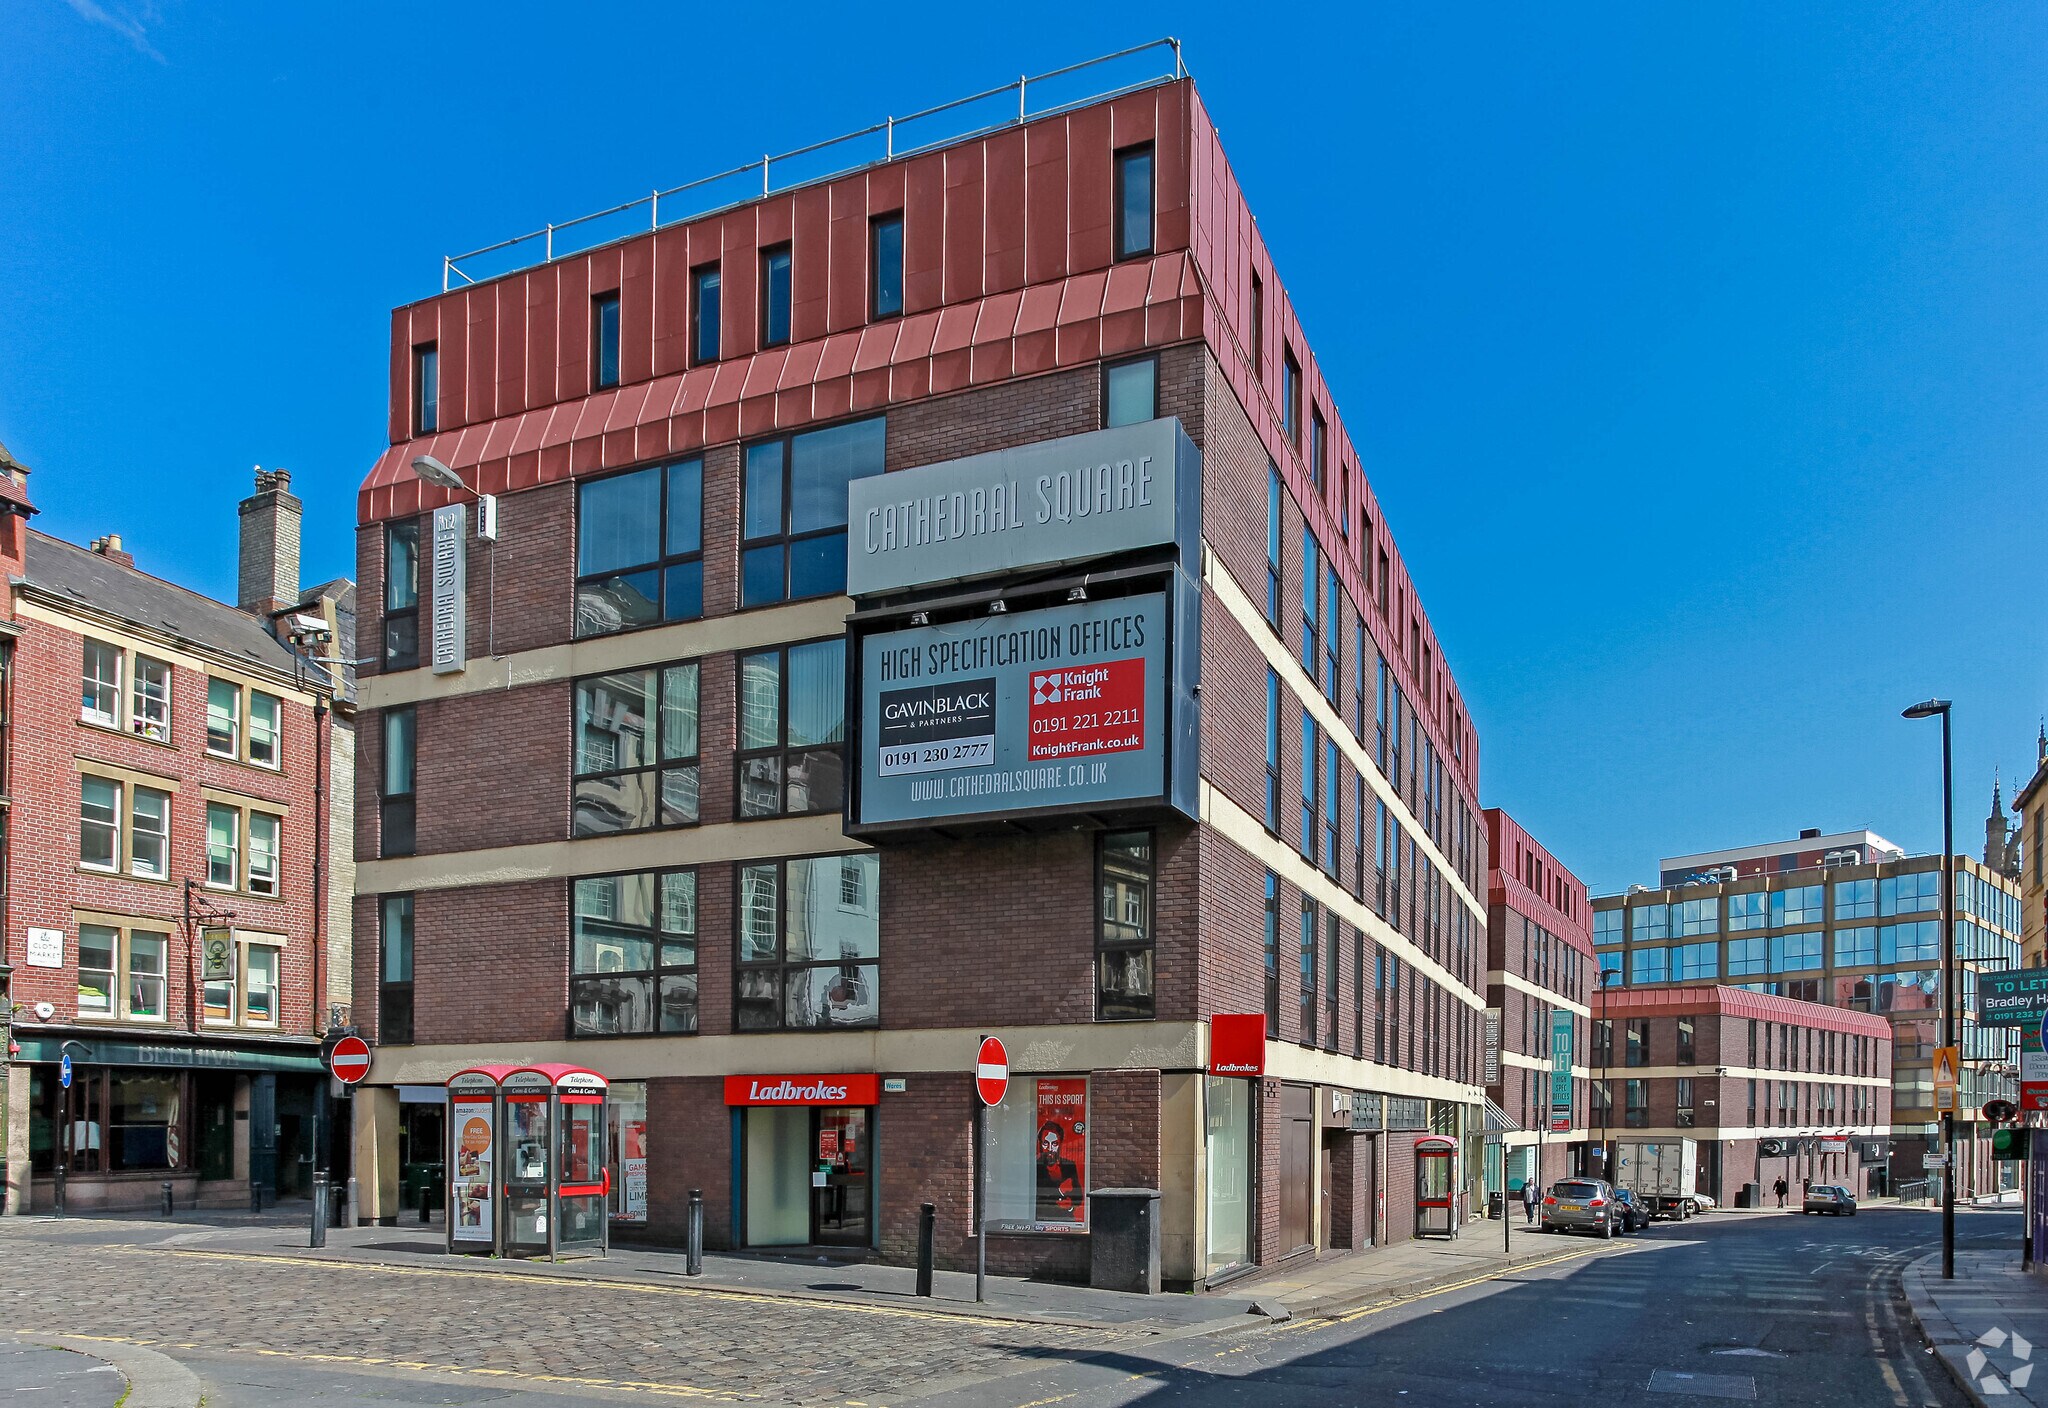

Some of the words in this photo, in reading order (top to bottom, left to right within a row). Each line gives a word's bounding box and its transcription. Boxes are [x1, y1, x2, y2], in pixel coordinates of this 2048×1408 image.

[865, 481, 1023, 554] CATHEDRAL
[1036, 456, 1152, 524] SQUARE
[437, 532, 456, 588] SQUARE
[436, 588, 455, 665] CATHEDRAL
[881, 646, 921, 681] HIGH
[928, 626, 1060, 675] SPECIFICATION
[1070, 614, 1145, 656] OFFICES
[1064, 668, 1109, 687] Knight
[1064, 685, 1102, 702] Frank
[885, 692, 989, 719] GAVINBLACK
[919, 716, 962, 727] PARTNERS
[1033, 716, 1068, 734] 0191
[1072, 713, 1099, 730] 221
[1103, 708, 1140, 726] 2211
[1033, 734, 1139, 757] KnightFrank.co.uk
[885, 751, 917, 767] 0191
[923, 747, 949, 763] 230
[953, 743, 989, 759] 2777
[911, 762, 1107, 801] WWW.CATHEDRALSQUARE.CO.UK
[33, 942, 59, 950] CLOTH
[30, 951, 60, 959] MARKET
[1982, 973, 2022, 981] RESTAURANT
[1995, 981, 2015, 993] TO
[2020, 978, 2048, 991] LET
[1986, 996, 2033, 1009] Bradley
[1994, 1012, 2014, 1020] 0191
[1486, 1021, 1497, 1046] SQUARE
[1555, 1033, 1568, 1052] TO
[1216, 1063, 1258, 1072] Ladbrokes
[1486, 1047, 1497, 1082] CATHEDRAL
[1553, 1053, 1571, 1071] LET
[461, 1076, 484, 1085] Telephone
[515, 1076, 539, 1084] Telephone
[570, 1076, 594, 1085] Telephone
[584, 1087, 597, 1095] Cards
[750, 1081, 847, 1100] Ladbrokes
[1039, 1094, 1053, 1104] THIS
[1055, 1094, 1061, 1104] IS
[1063, 1094, 1084, 1104] SPORT
[470, 1127, 483, 1135] FREE
[1001, 1223, 1015, 1231] FREE
